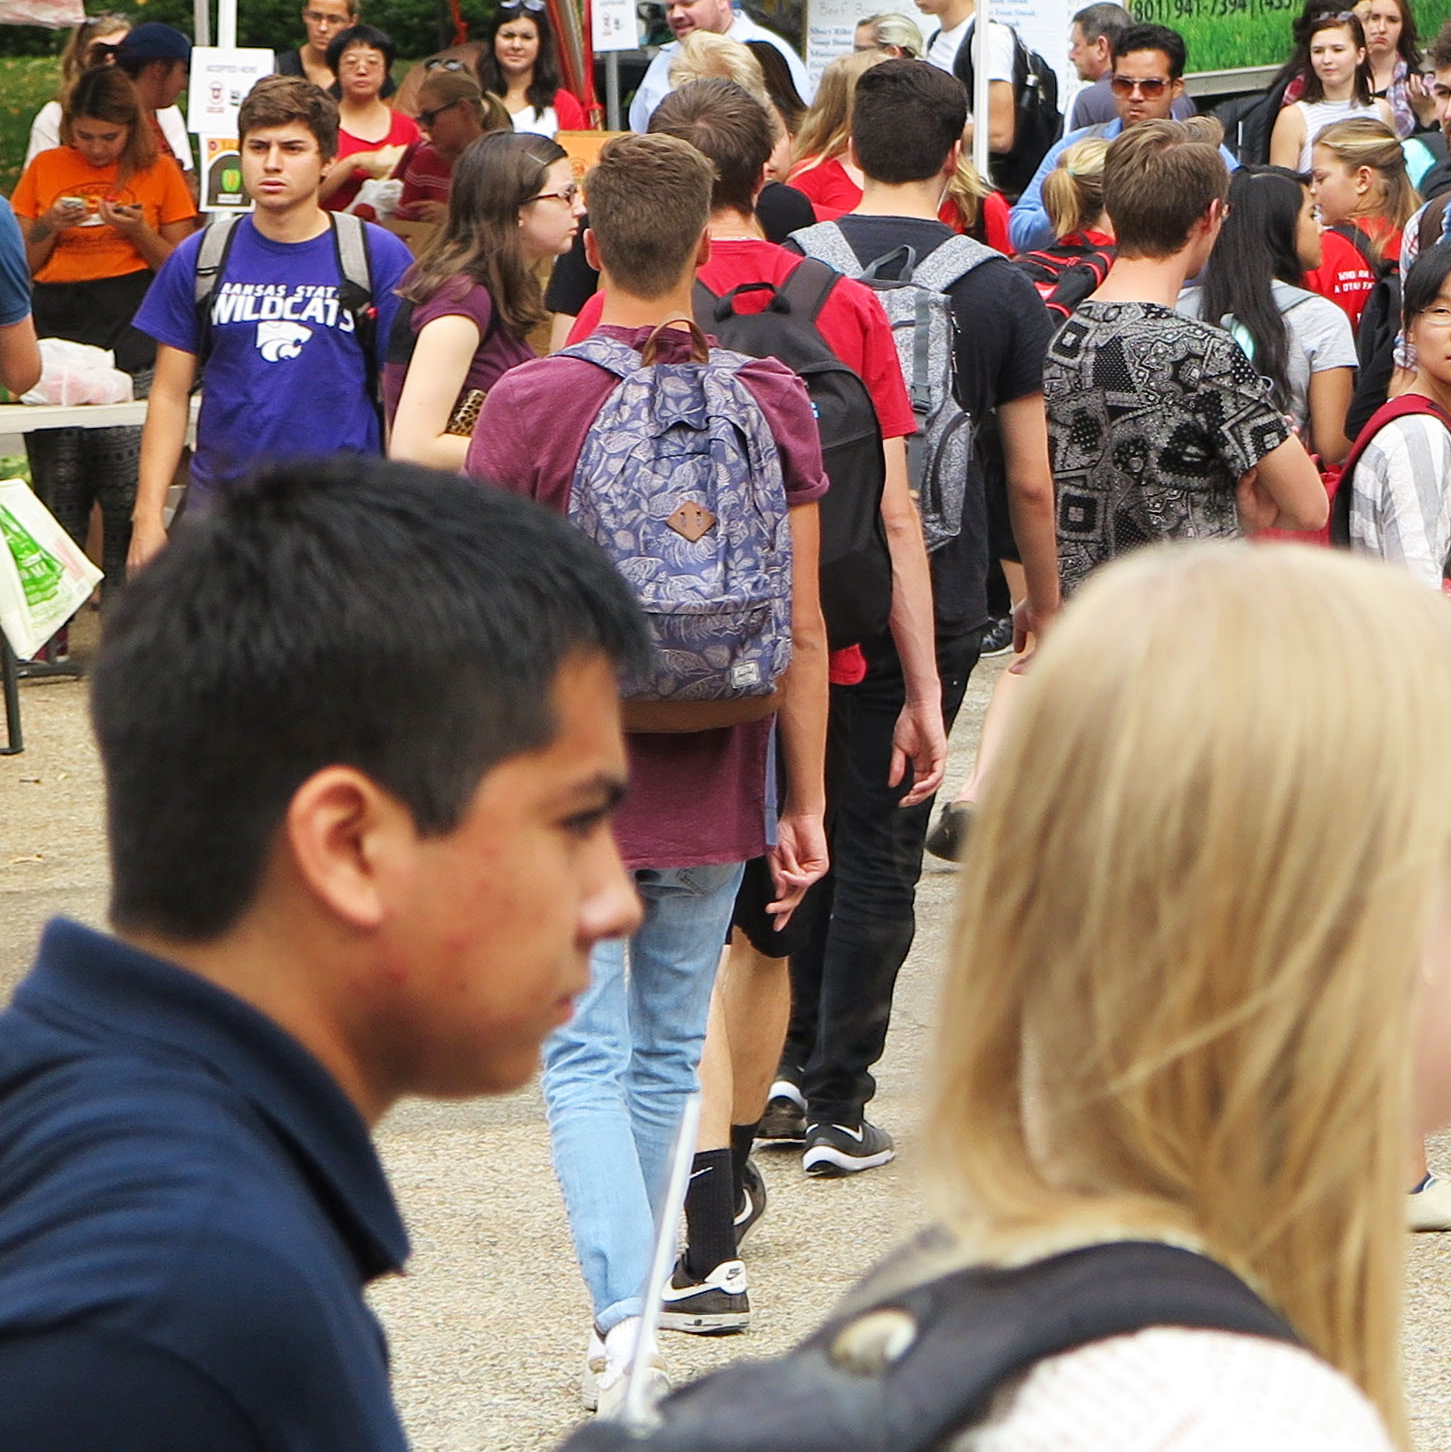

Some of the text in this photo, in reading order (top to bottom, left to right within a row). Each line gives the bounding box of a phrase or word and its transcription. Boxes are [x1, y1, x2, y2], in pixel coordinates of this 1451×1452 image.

[221, 282, 340, 298] KANSAS STAT
[211, 294, 355, 333] WILDCATS
